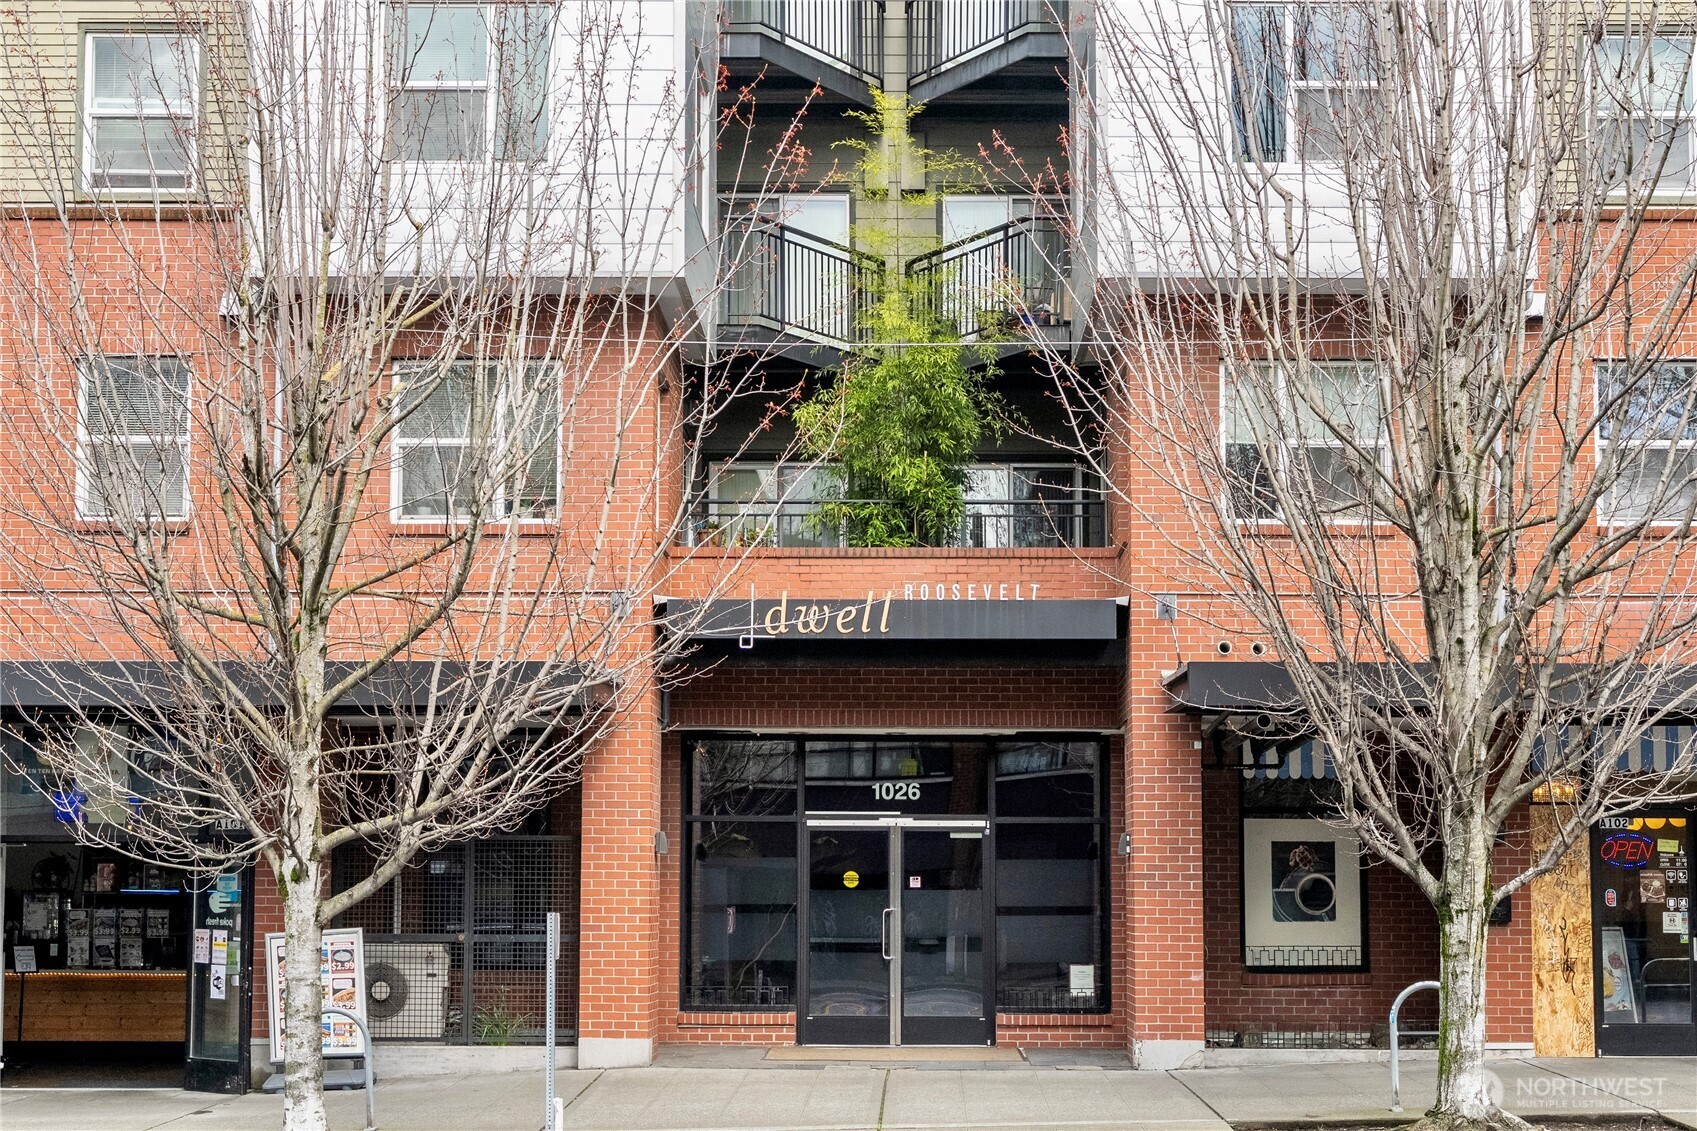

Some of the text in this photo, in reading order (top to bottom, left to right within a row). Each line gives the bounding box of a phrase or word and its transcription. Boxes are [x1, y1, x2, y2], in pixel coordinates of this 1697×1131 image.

[904, 584, 1040, 600] ROOSEVELT
[764, 590, 893, 635] dwell
[872, 782, 921, 800] 1026
[1600, 818, 1628, 828] A102
[1600, 840, 1655, 860] OPEN
[331, 962, 355, 970] $2.99
[332, 1001, 356, 1010] $3.99
[332, 1037, 357, 1047] $3.99
